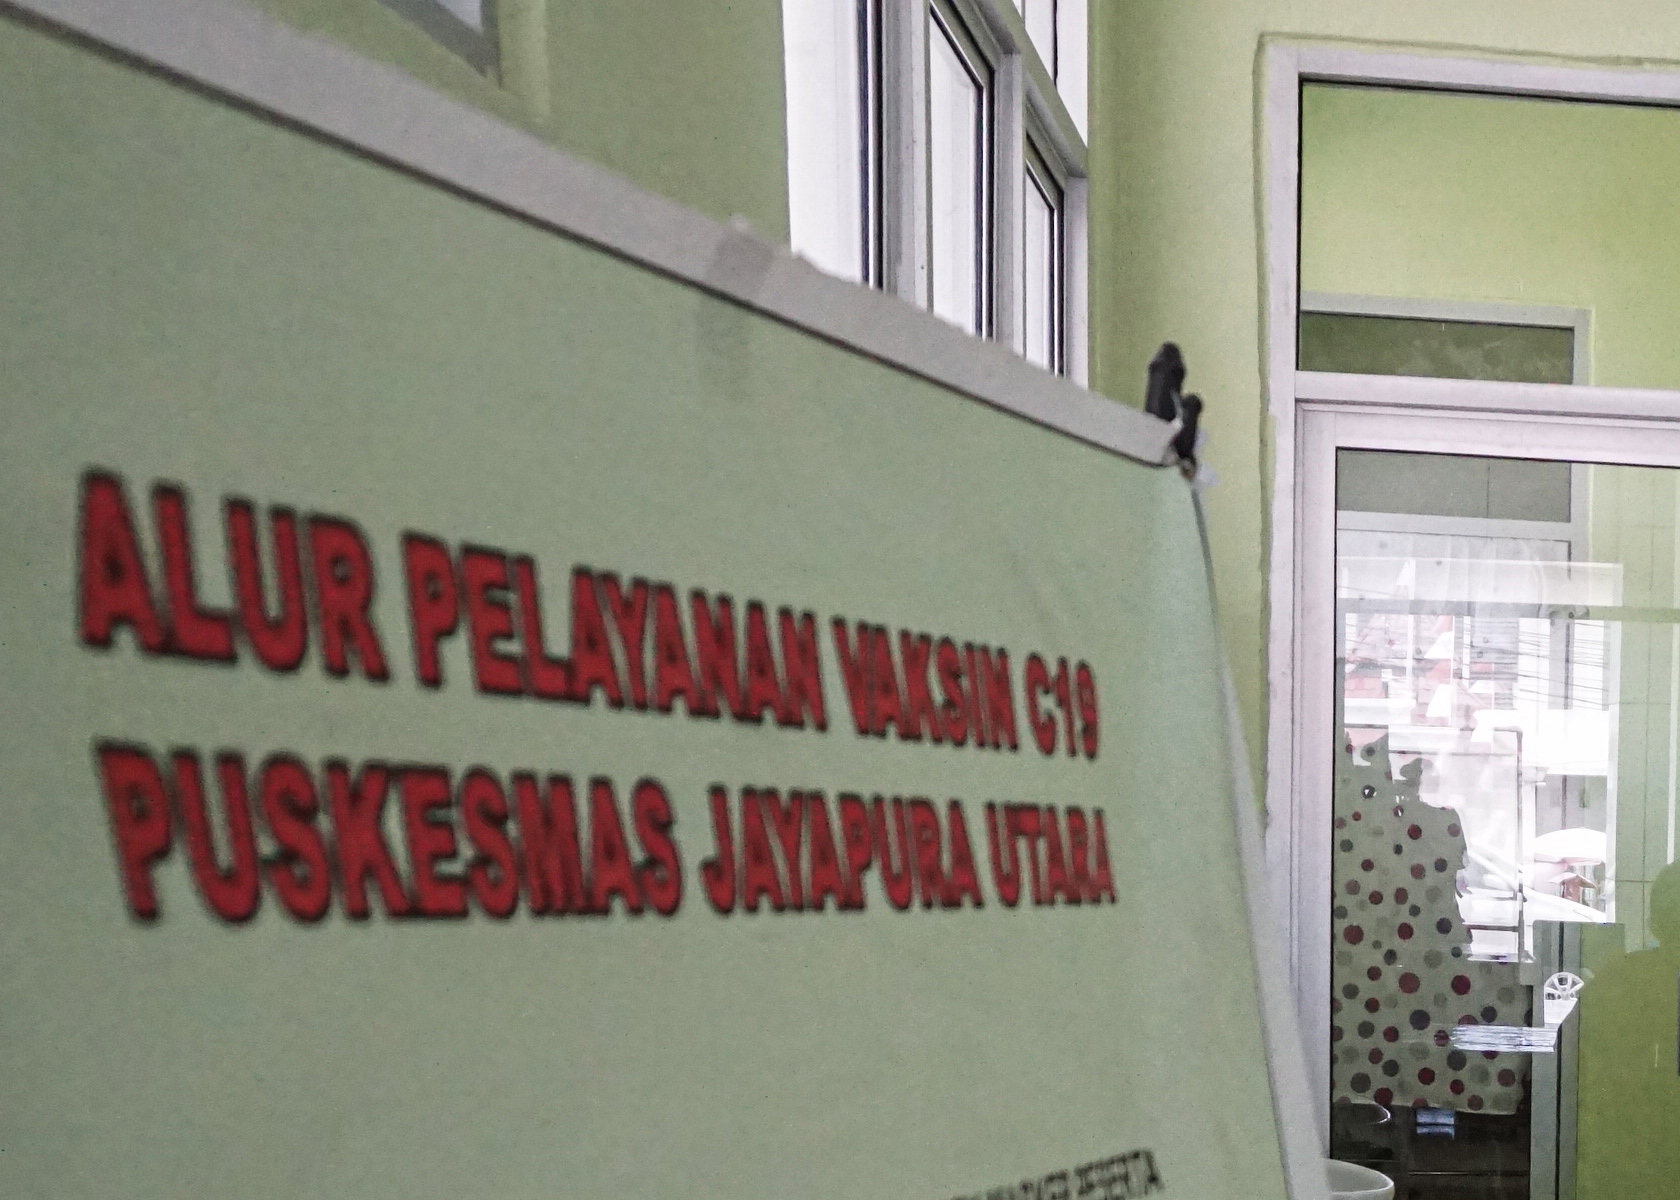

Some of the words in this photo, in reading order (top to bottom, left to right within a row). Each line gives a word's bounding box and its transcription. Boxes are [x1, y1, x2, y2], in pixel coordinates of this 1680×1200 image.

[77, 467, 388, 683] ALUR
[401, 531, 830, 733] PELAYANAN
[832, 617, 1018, 752] VAKSIN
[1022, 651, 1099, 760] C19
[94, 739, 682, 925] PUSKESMAS
[701, 782, 984, 914] JAYAPURA
[988, 803, 1117, 906] UTARA
